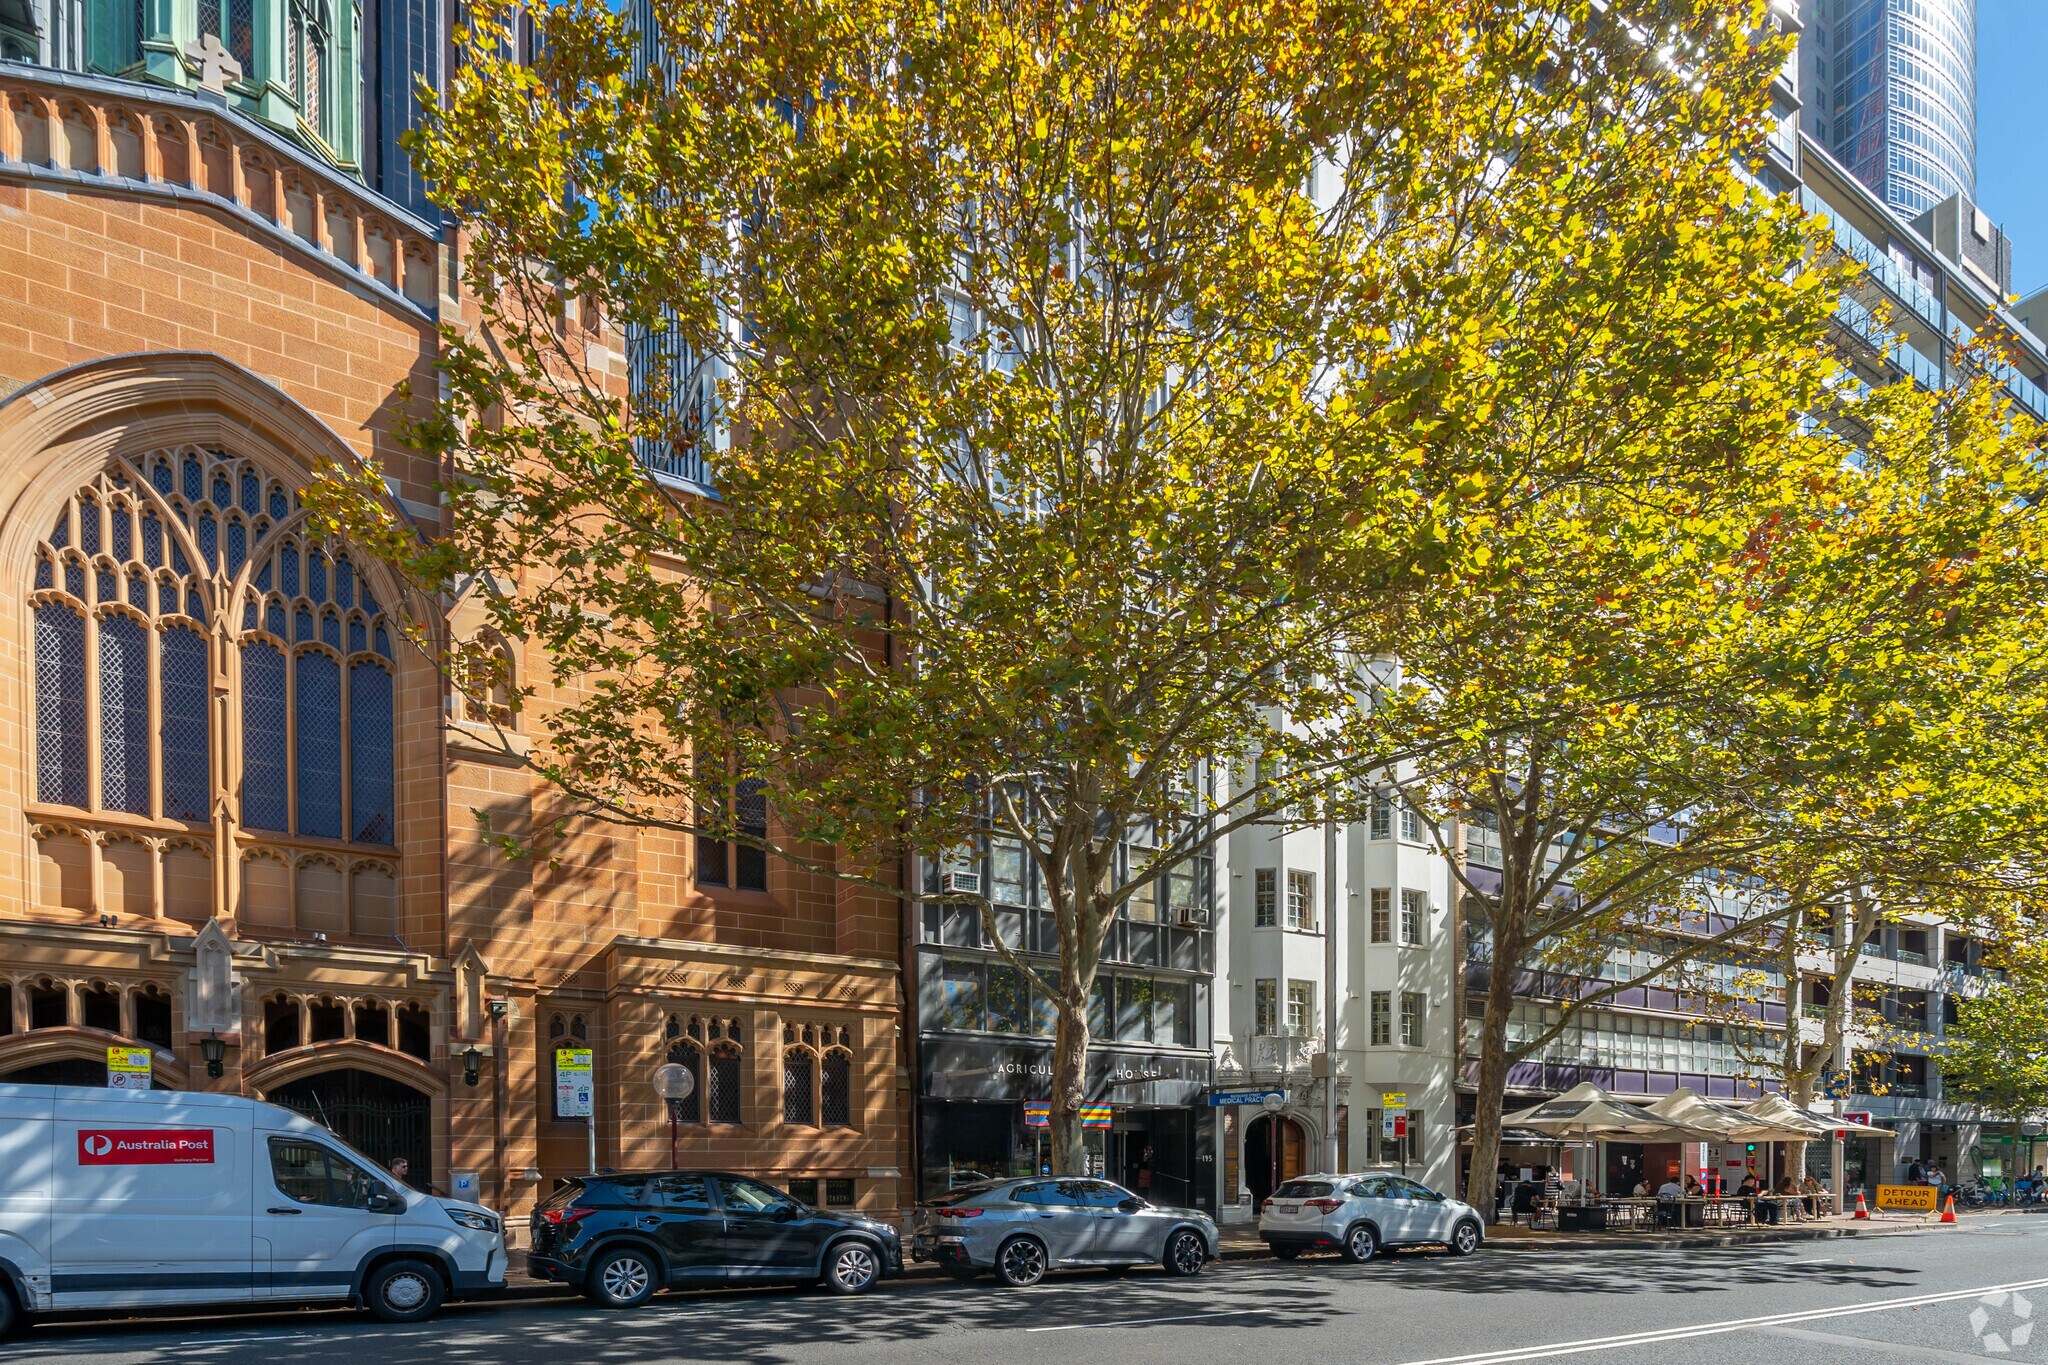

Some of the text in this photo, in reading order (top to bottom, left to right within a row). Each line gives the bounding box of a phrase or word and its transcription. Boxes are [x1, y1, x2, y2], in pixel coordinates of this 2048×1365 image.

[998, 1063, 1157, 1079] AGRICUL HOSE
[117, 1140, 208, 1150] Australia Post
[1884, 1189, 1930, 1197] DETOUR
[1885, 1198, 1927, 1206] AHEAD
